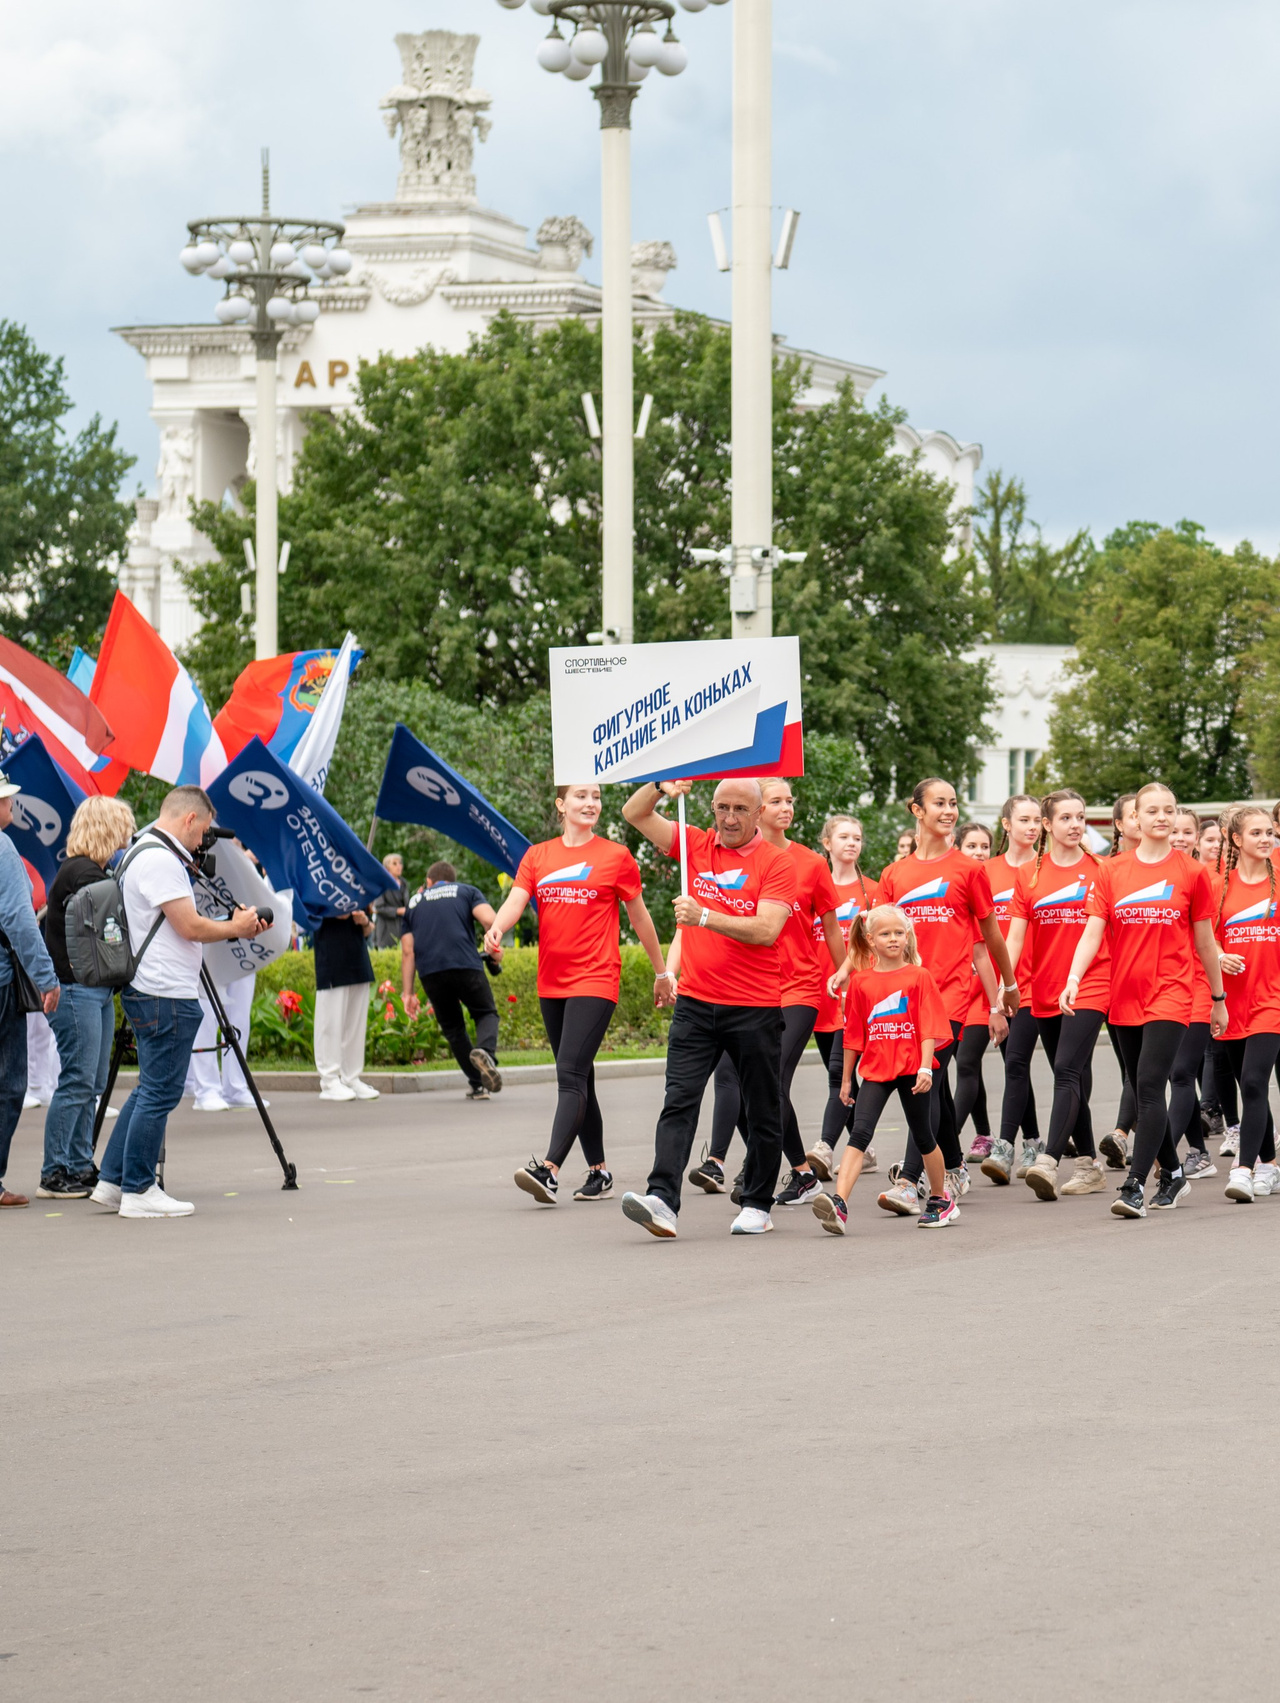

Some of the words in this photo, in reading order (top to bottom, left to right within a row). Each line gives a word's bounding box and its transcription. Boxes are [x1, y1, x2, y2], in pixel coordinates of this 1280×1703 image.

[565, 656, 627, 668] СПОРТИВНОЕ
[592, 681, 672, 746] ФИГУРНОЕ
[594, 718, 658, 776] КАТАНИЕ
[661, 705, 681, 736] НА
[684, 661, 753, 721] КОНЬКАХ
[905, 905, 955, 917] ОРТИВНОЕ
[869, 1033, 912, 1041] ЕСТВИЕ
